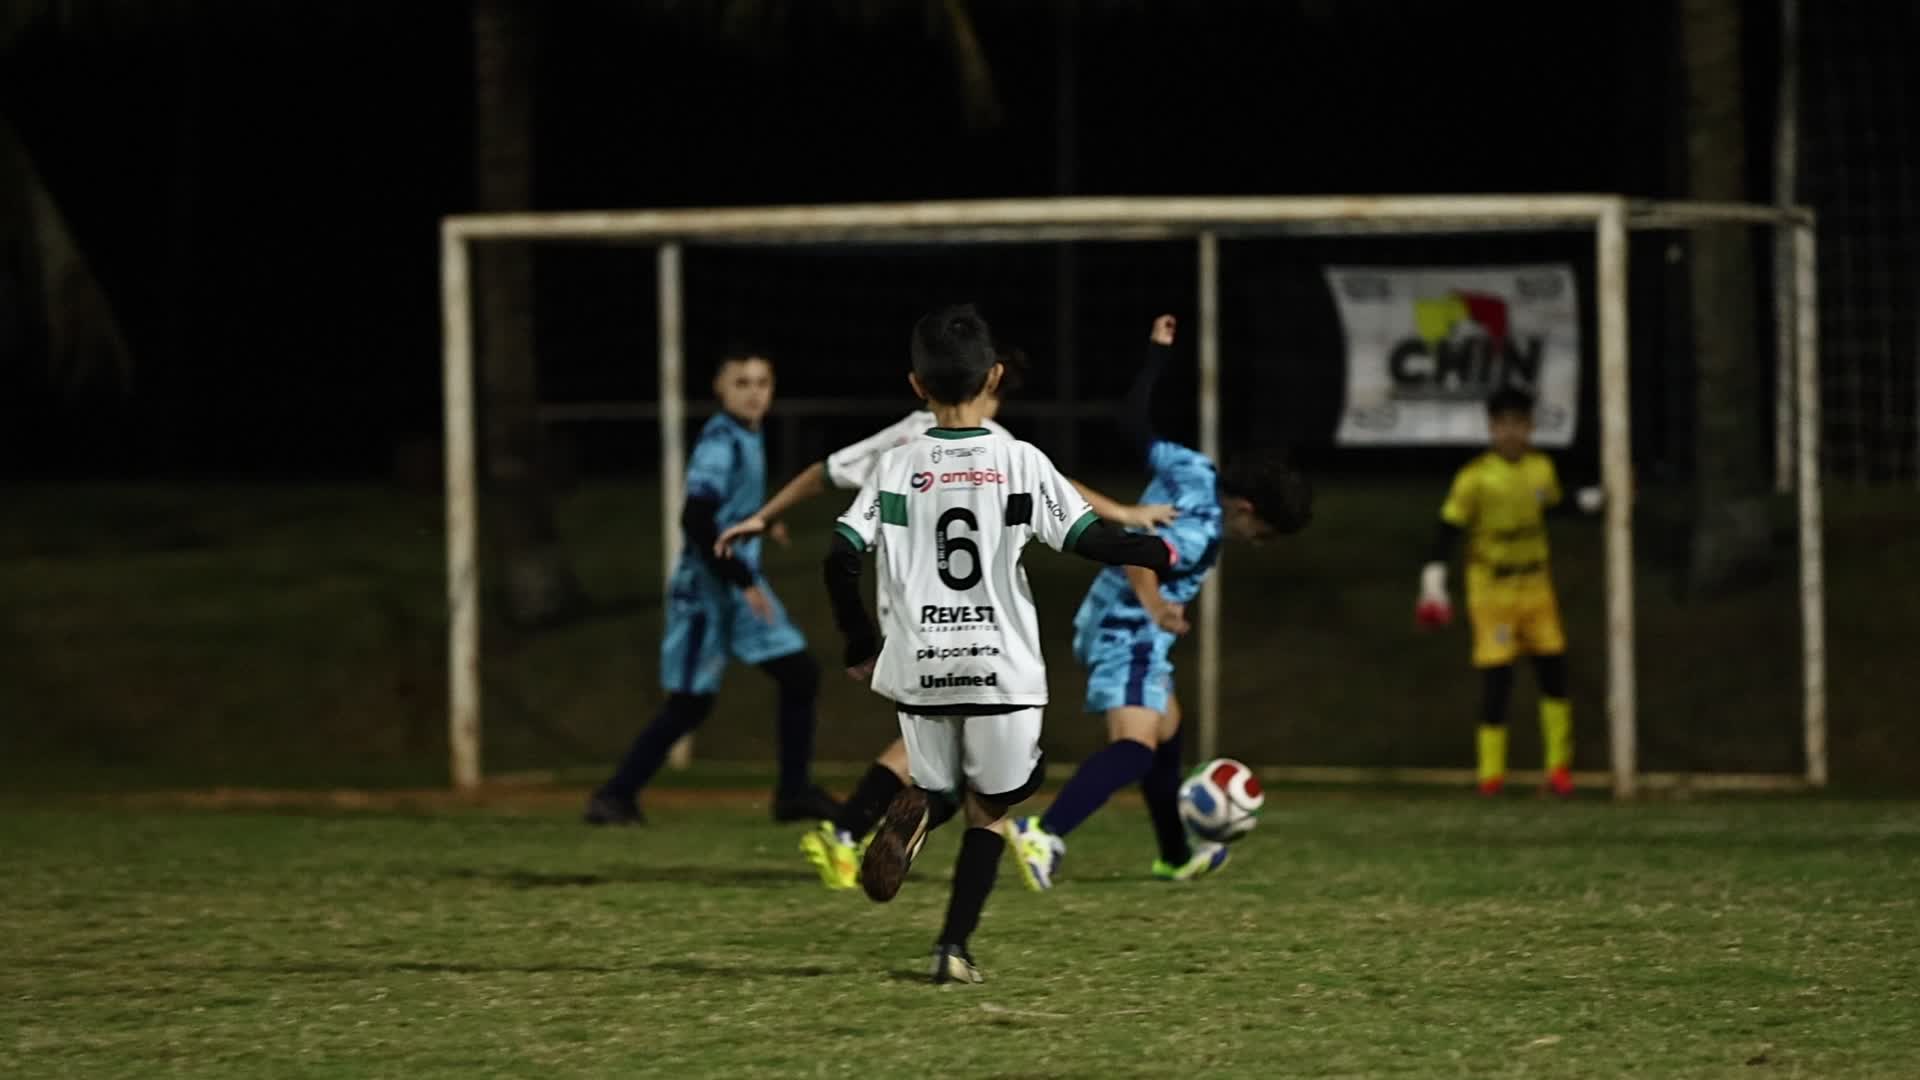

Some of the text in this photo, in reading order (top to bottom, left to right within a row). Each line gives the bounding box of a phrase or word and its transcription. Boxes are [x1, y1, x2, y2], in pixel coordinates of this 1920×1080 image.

[1389, 334, 1546, 388] CHIN
[940, 467, 1006, 486] amigão
[936, 507, 983, 591] 6
[920, 605, 994, 624] REVEST
[920, 672, 998, 689] Unimed
